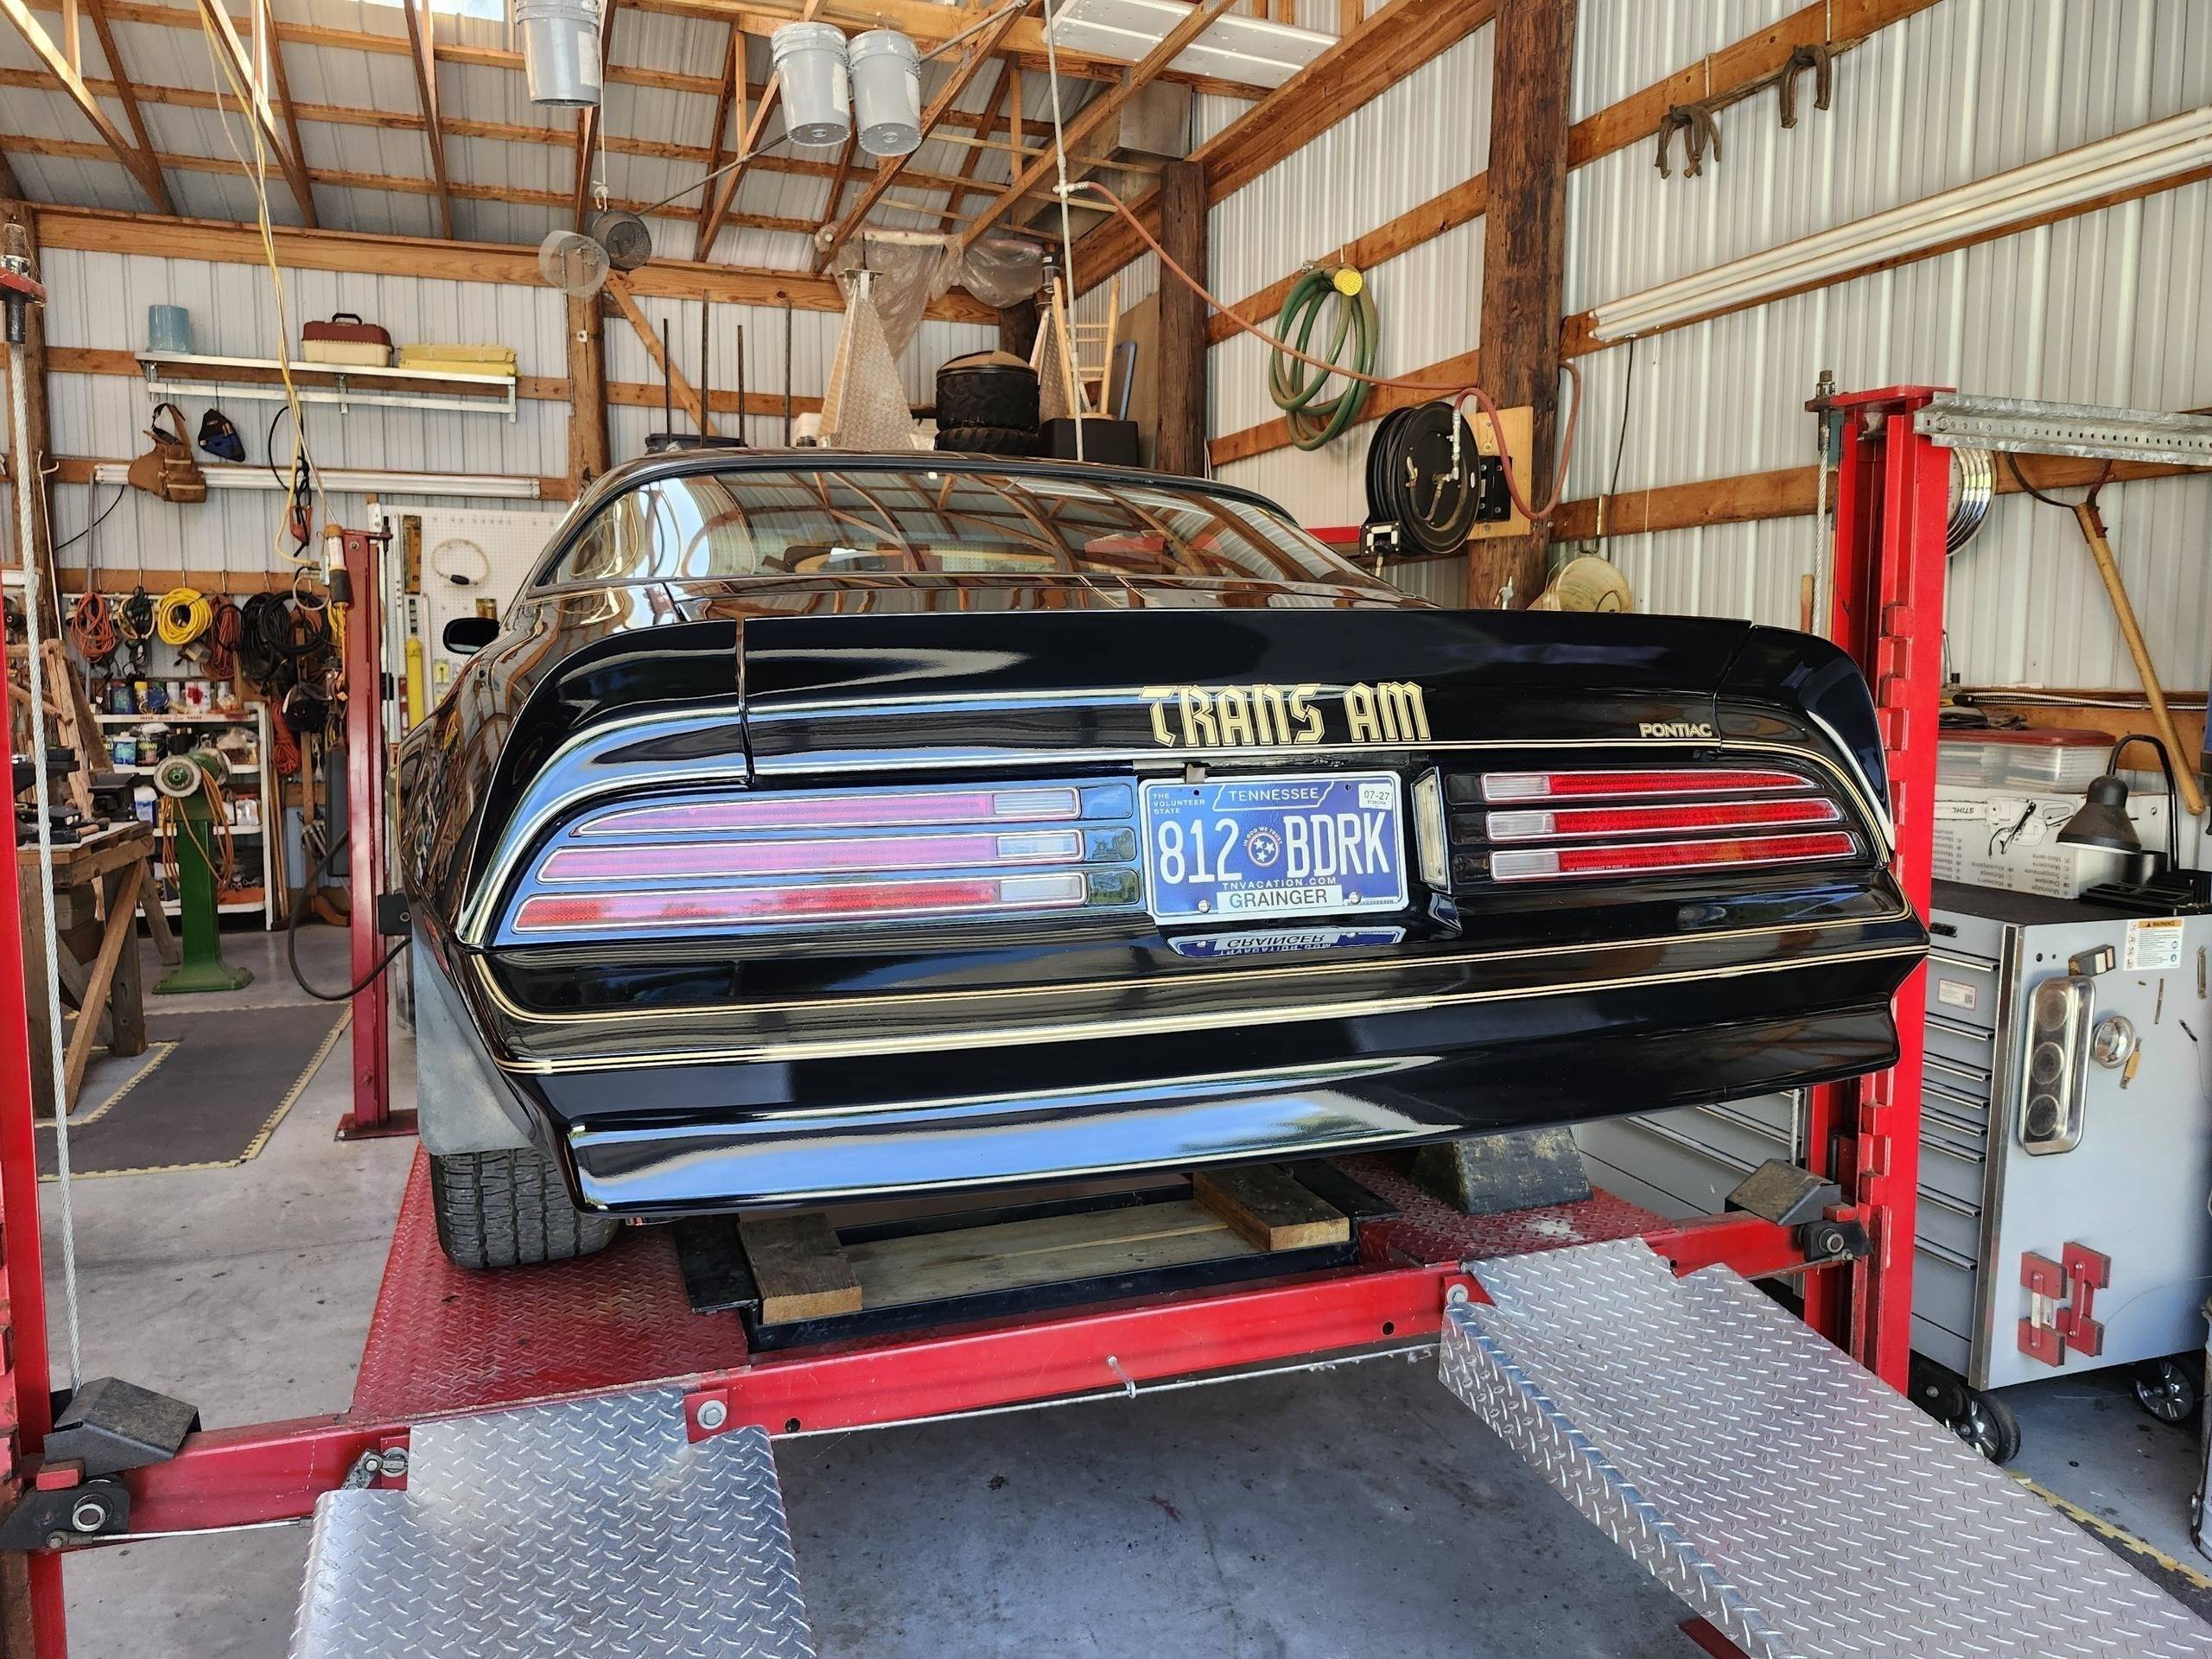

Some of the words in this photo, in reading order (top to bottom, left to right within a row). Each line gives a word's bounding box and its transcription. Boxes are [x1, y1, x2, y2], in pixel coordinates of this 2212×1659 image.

[1139, 683, 1325, 747] TRANS
[1343, 681, 1431, 742] AM
[1638, 722, 1713, 738] PONTIAC
[1228, 787, 1319, 802] TENNESSEE
[1363, 790, 1390, 801] 07-27
[1154, 798, 1205, 807] VOLUNTEER
[1246, 828, 1258, 839] GOD
[1158, 817, 1243, 885] 812
[1283, 811, 1390, 878] BDRK
[1222, 876, 1337, 890] TNVACATION.COM
[1229, 888, 1328, 909] GRAINGER
